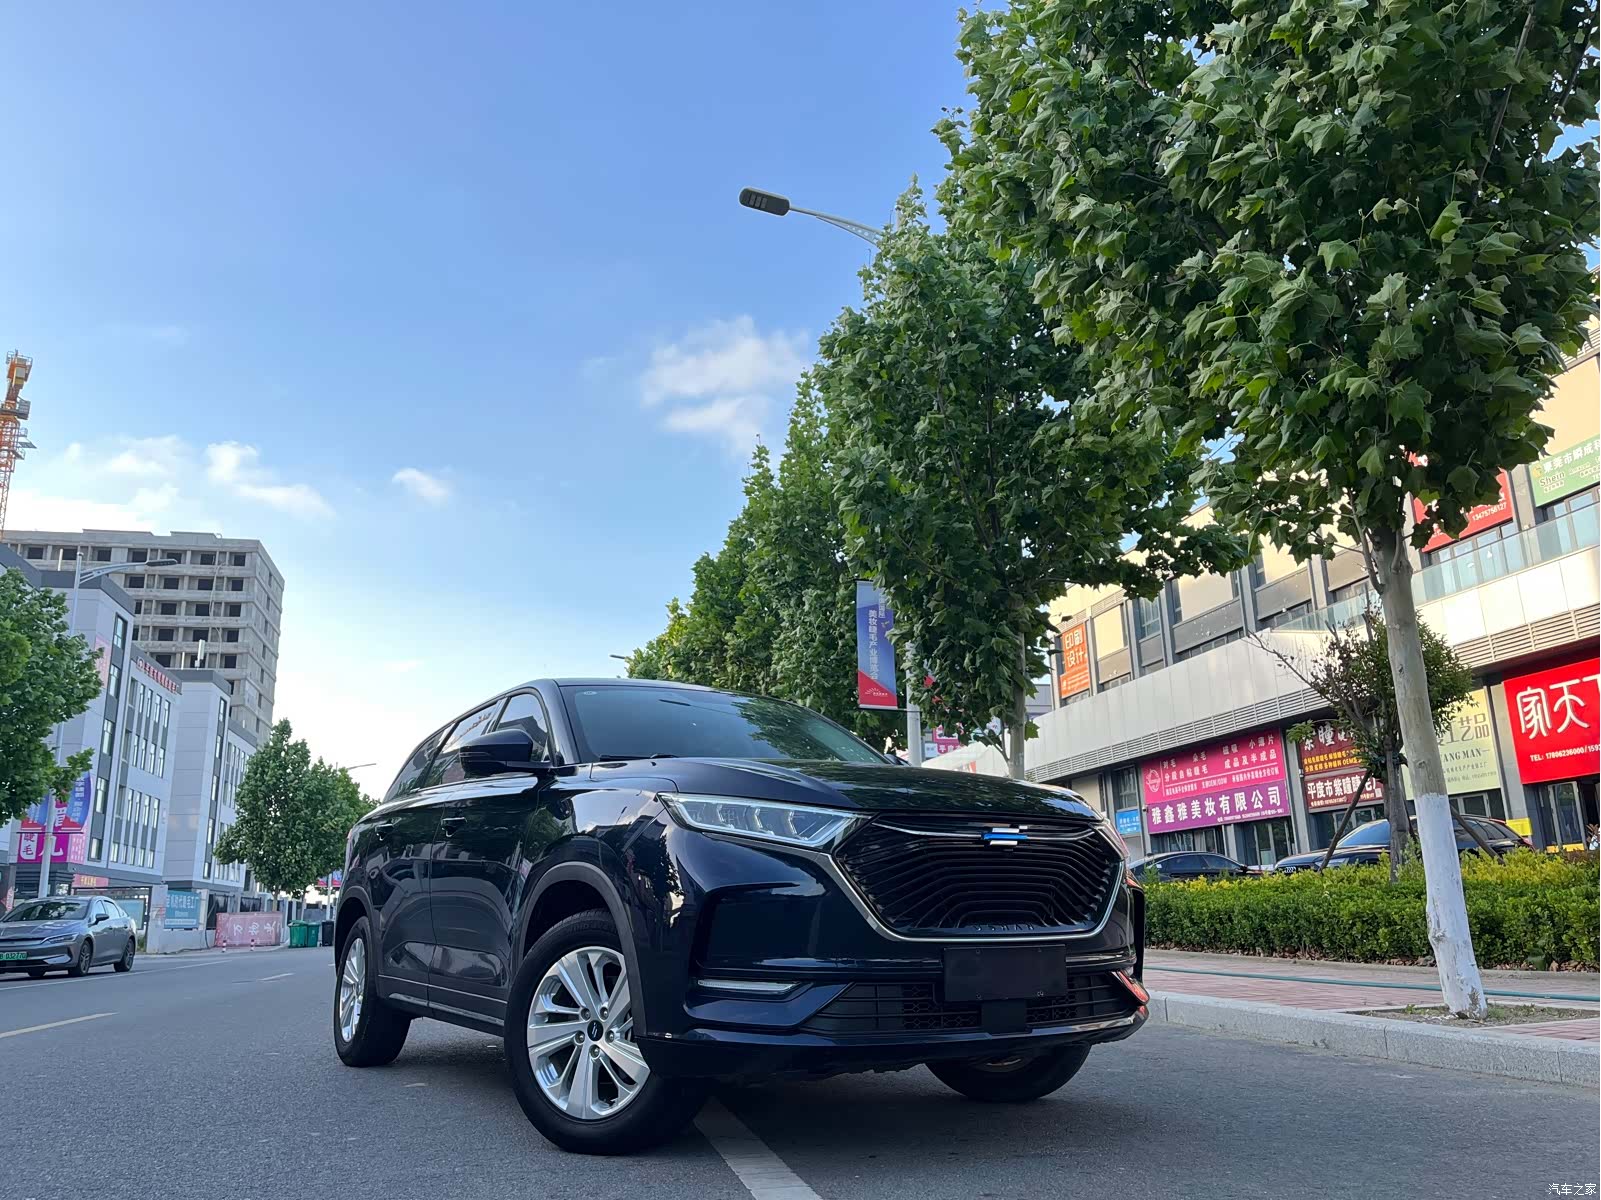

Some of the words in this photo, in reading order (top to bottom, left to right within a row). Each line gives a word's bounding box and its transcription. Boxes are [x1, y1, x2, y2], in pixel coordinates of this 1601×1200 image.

[1539, 471, 1565, 488] Shein
[1440, 751, 1461, 764] ANG
[1462, 748, 1482, 760] MAN
[1151, 786, 1281, 825] 雅鑫雅美妆有限公司
